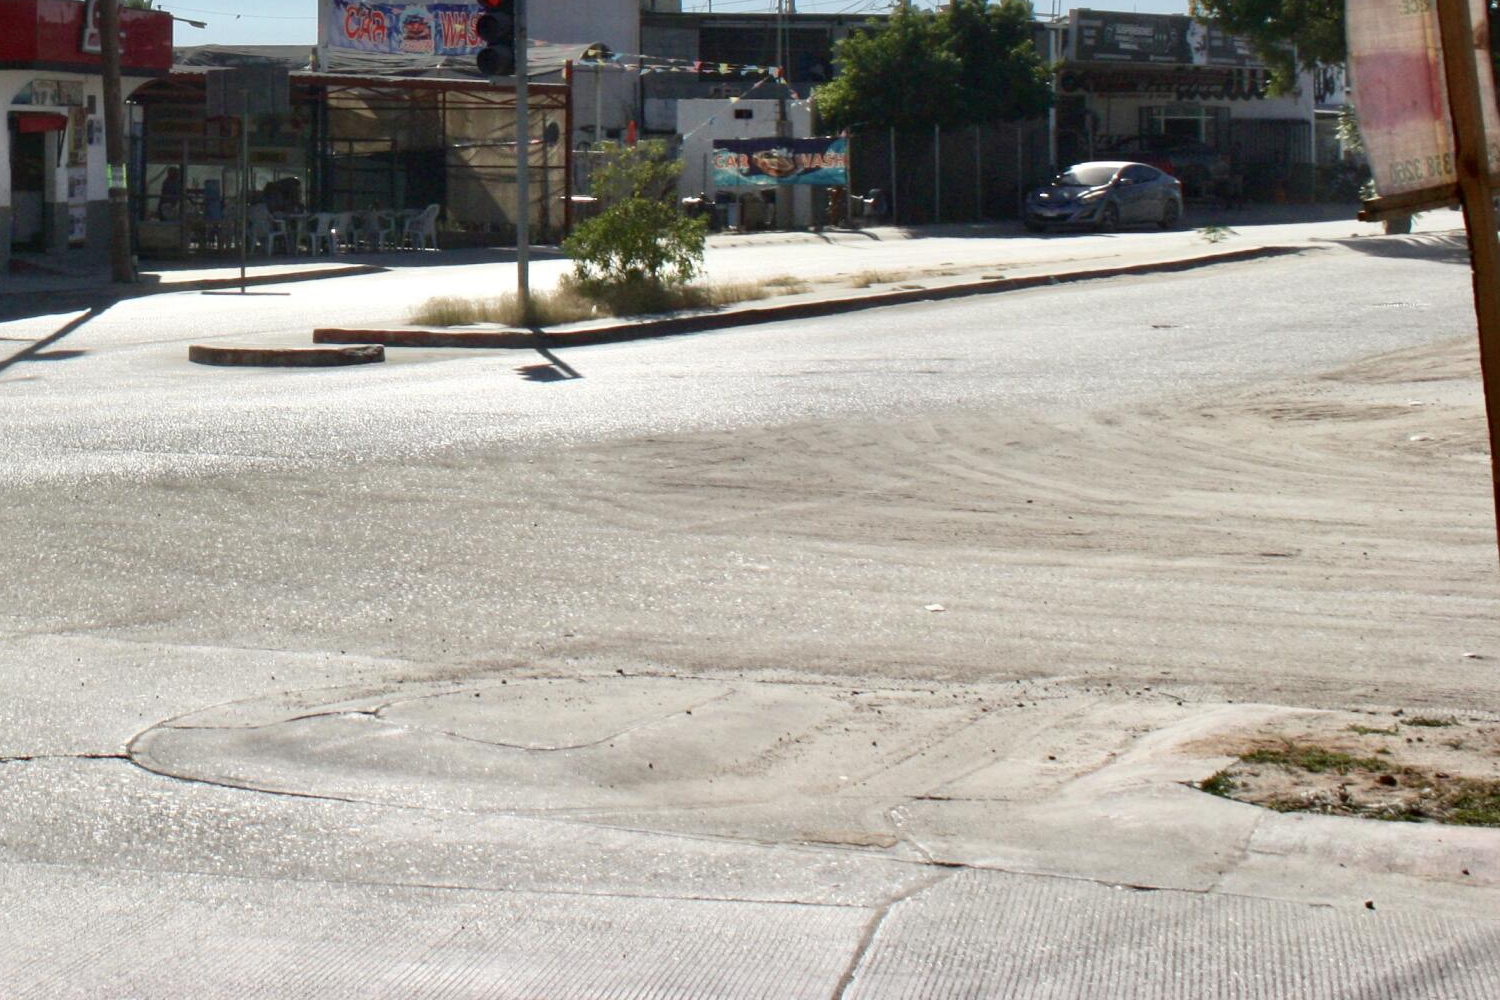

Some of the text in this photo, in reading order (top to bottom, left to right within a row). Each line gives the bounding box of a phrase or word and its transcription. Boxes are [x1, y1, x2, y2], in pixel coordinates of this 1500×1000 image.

[344, 4, 487, 48] CAR WAS
[713, 152, 848, 169] CAR WASH
